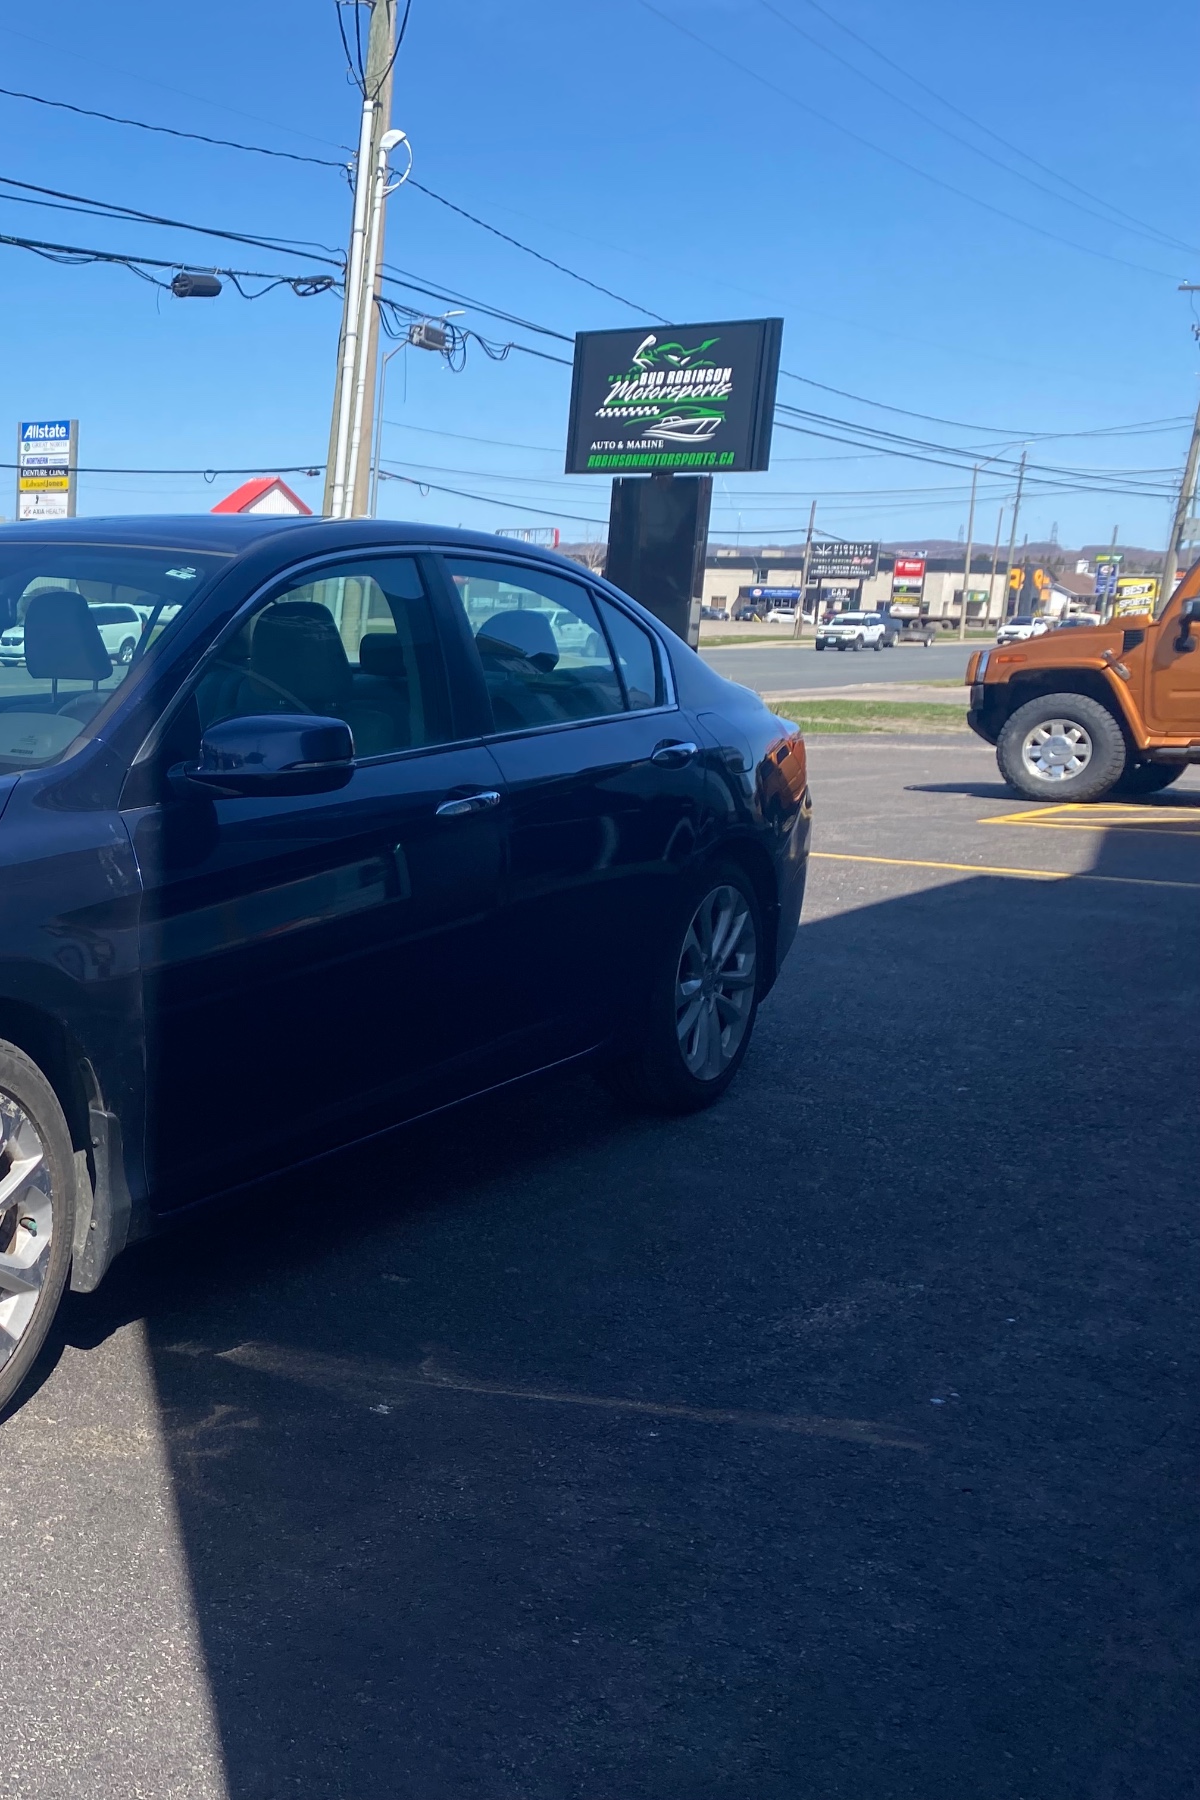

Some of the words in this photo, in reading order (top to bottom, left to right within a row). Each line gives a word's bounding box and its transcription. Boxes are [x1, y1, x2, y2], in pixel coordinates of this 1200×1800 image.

[639, 371, 663, 386] BUD
[667, 368, 732, 384] ROBINSON
[604, 379, 733, 406] Motorsports
[24, 424, 67, 439] Allstate
[590, 441, 616, 450] AUTO
[617, 440, 624, 449] &
[626, 439, 664, 449] MARINE
[587, 452, 735, 468] ROBINSONMOTORSPORTS.CA
[22, 469, 48, 477] DENTURE
[1125, 583, 1150, 596] BEST
[1119, 597, 1151, 608] SPORTS
